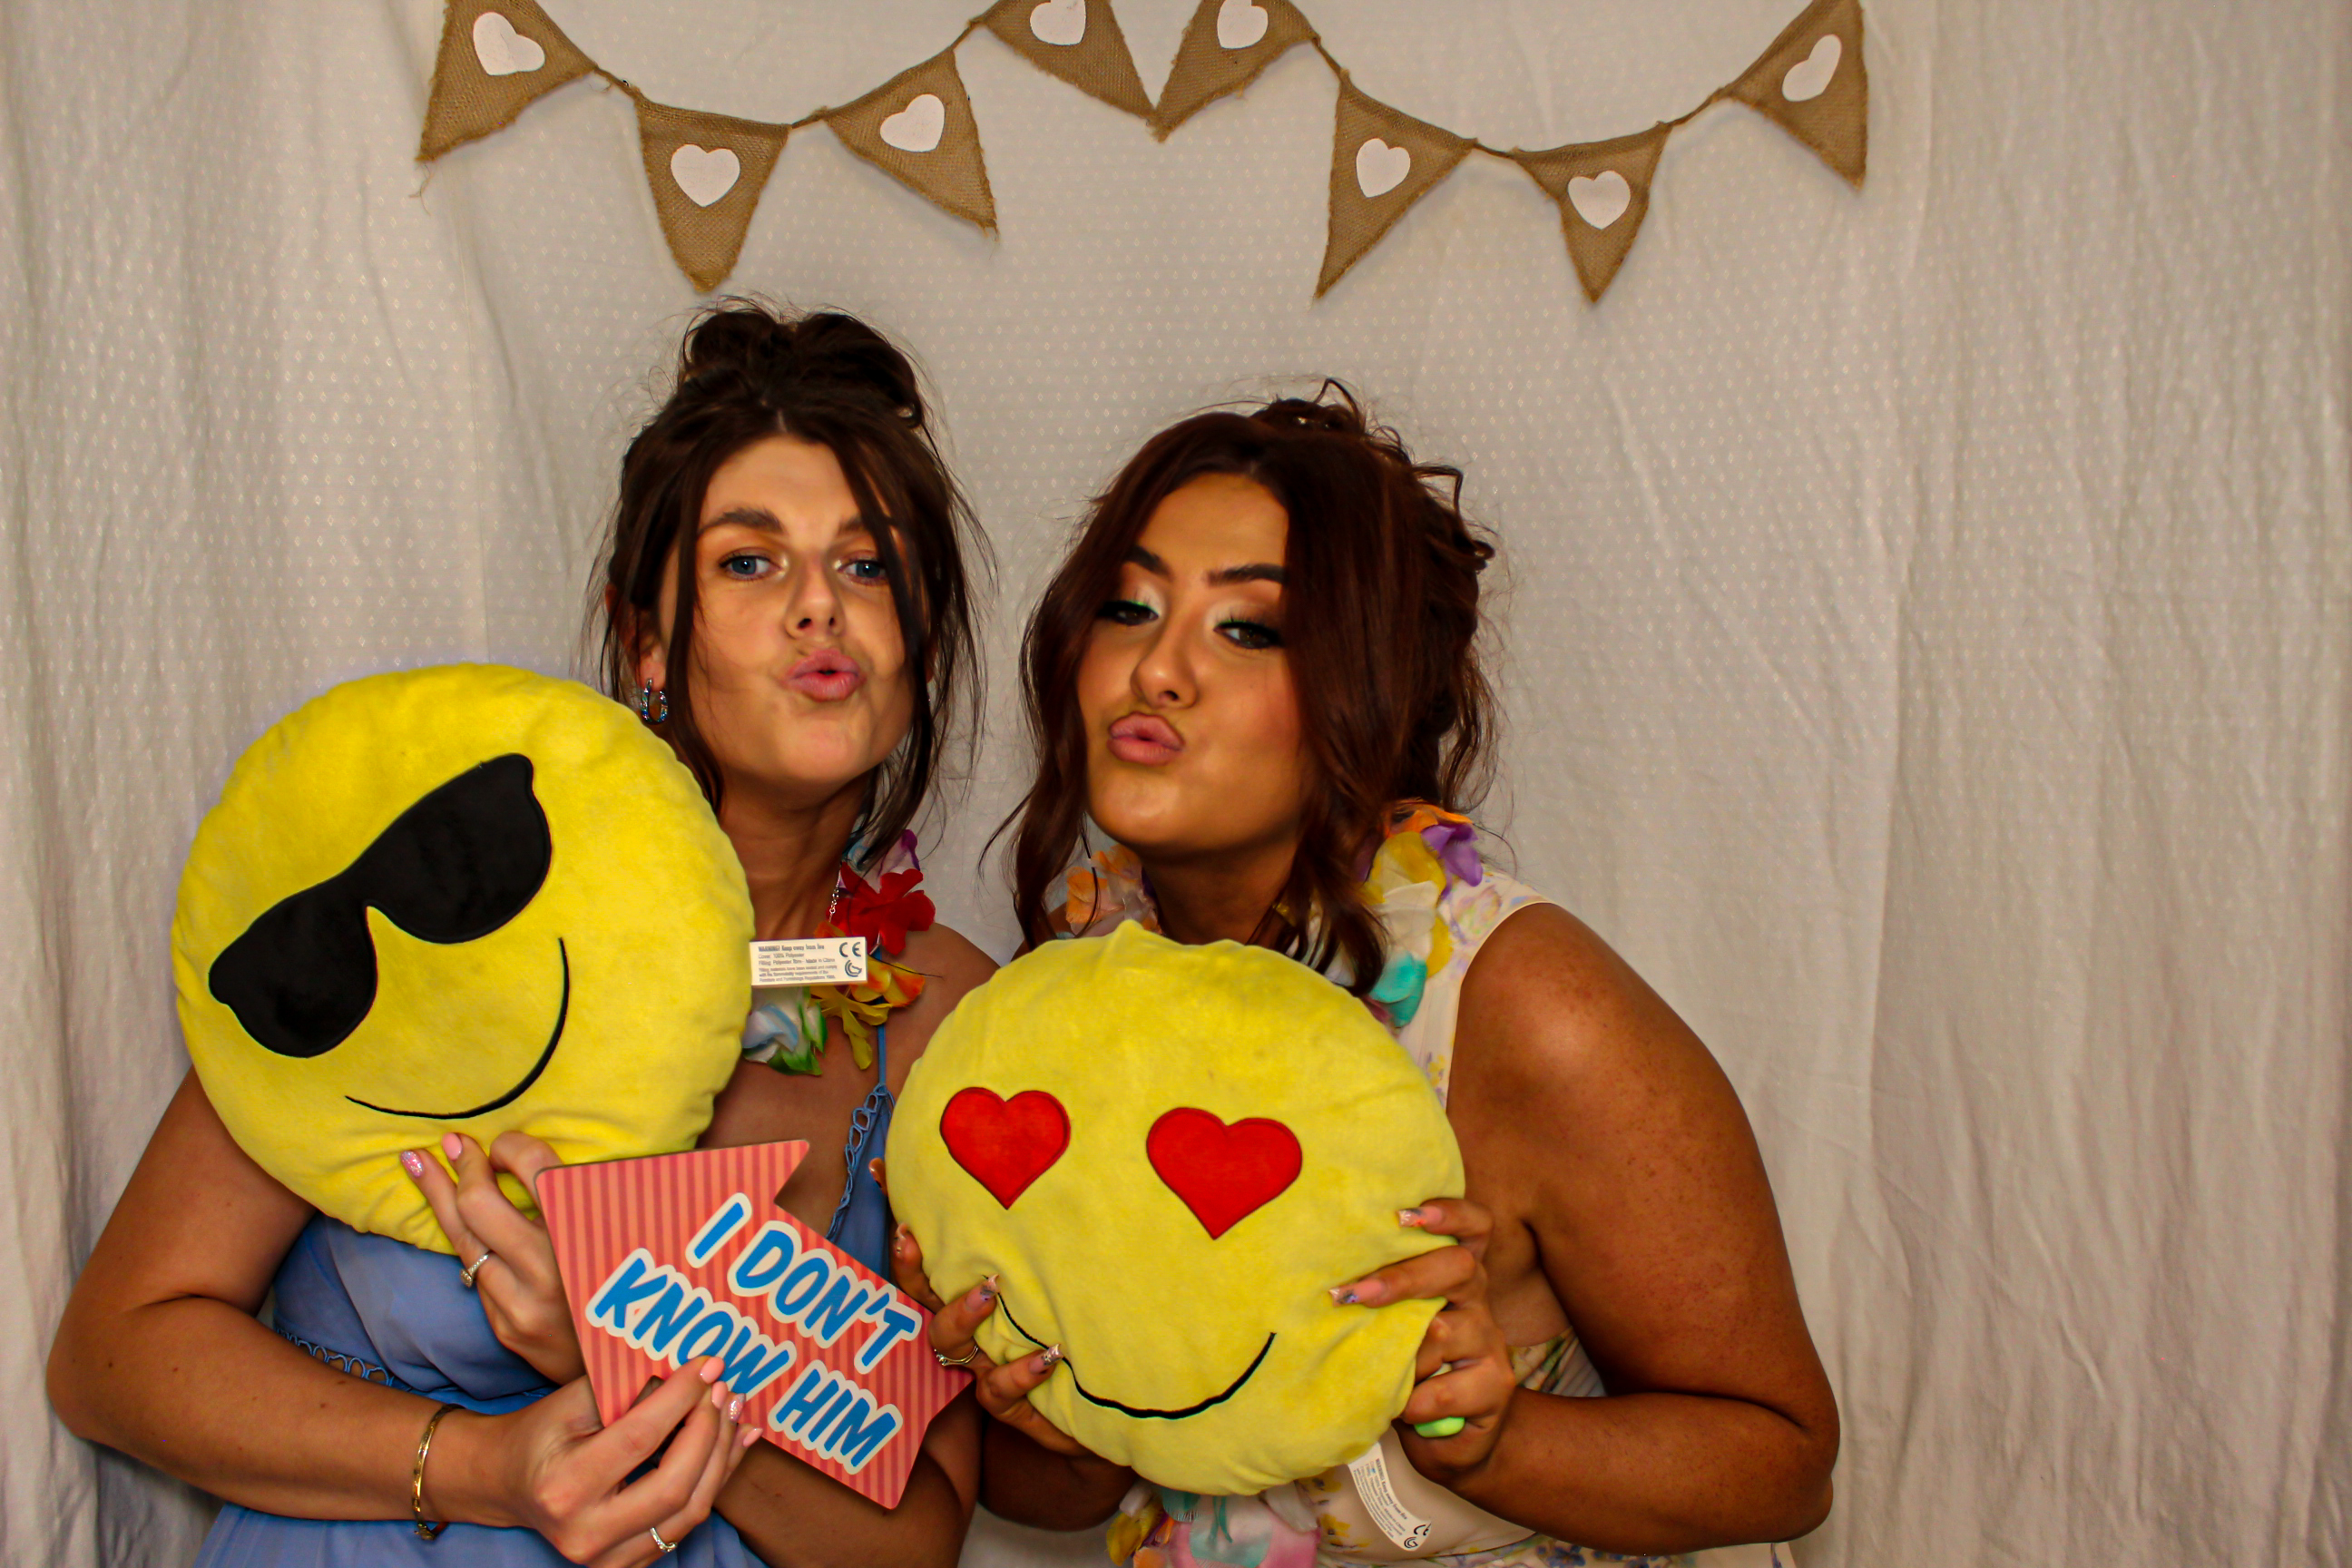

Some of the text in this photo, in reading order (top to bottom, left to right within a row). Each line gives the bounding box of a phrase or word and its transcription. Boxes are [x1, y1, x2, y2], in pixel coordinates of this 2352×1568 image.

[592, 1255, 899, 1470] KNOW HIM
[691, 1200, 919, 1370] I DON'T
